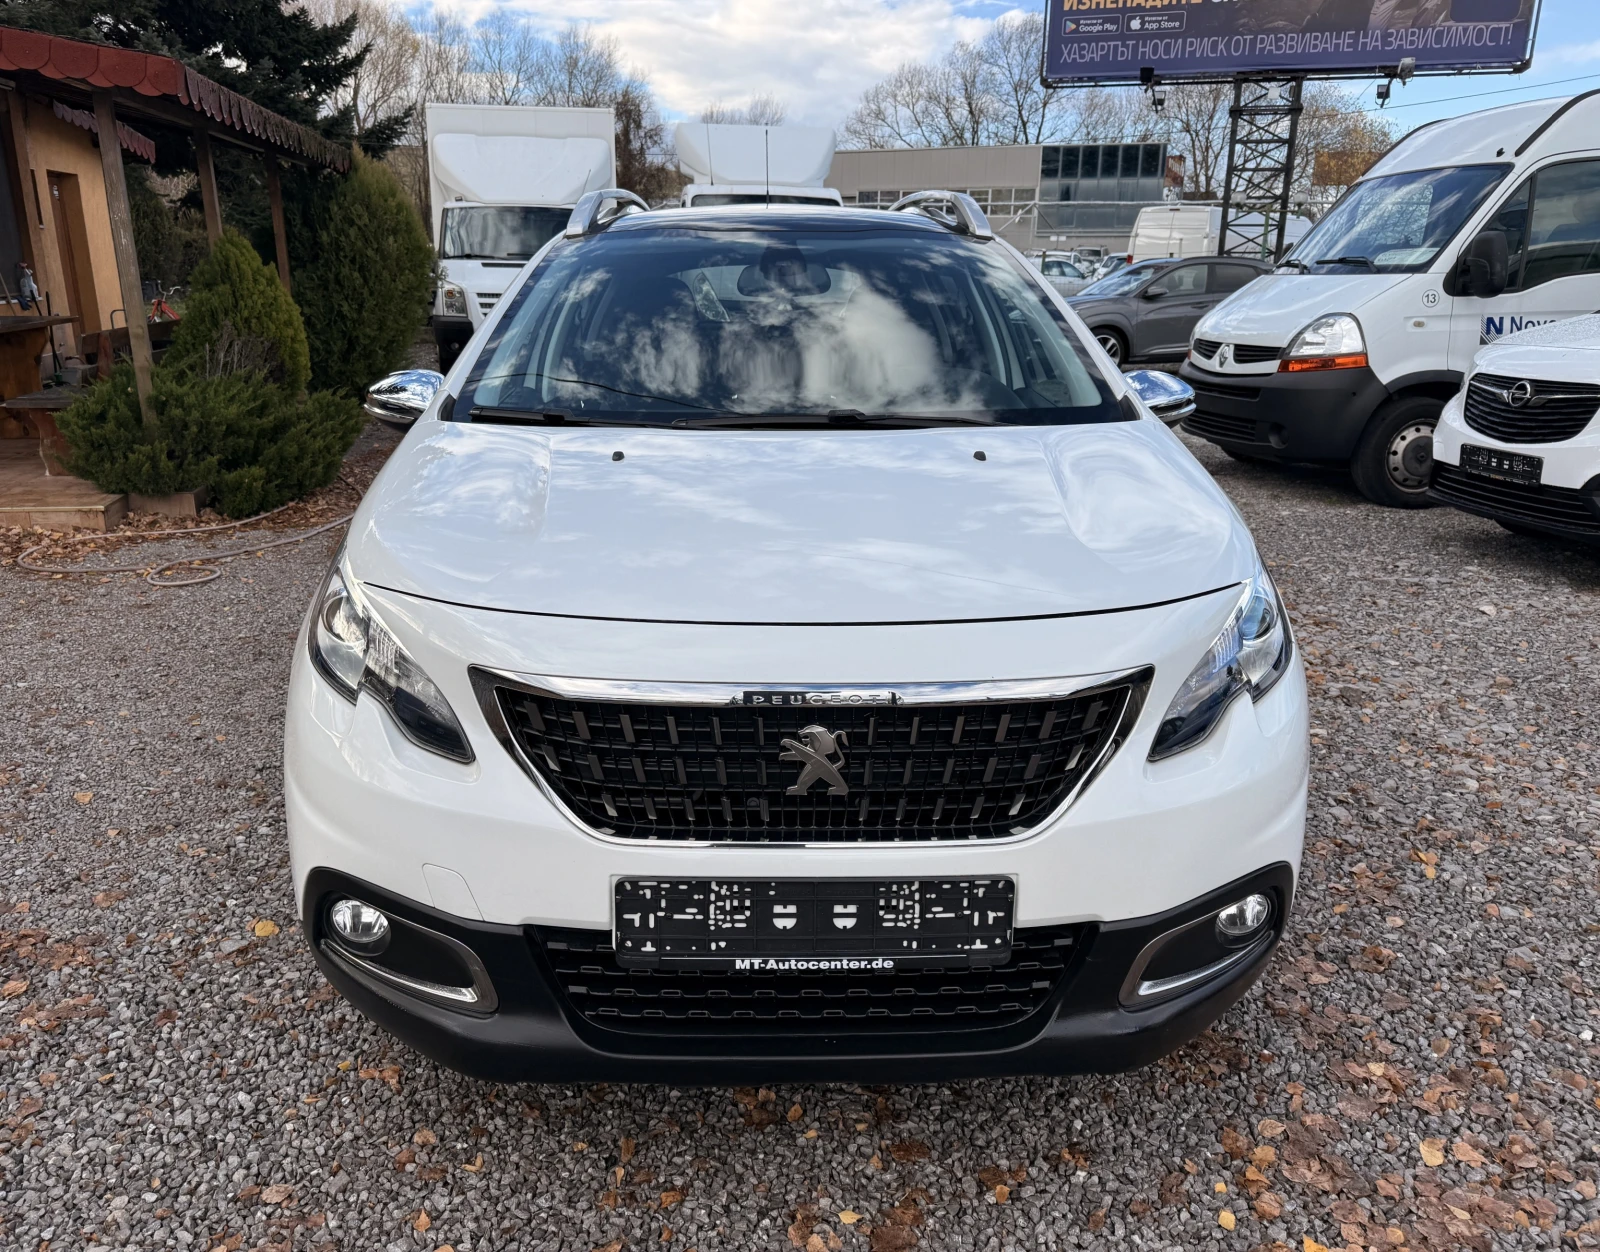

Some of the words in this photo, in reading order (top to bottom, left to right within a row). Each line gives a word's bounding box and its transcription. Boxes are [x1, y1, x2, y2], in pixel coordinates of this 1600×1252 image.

[1079, 24, 1103, 33] Google
[1103, 23, 1118, 32] Play
[1143, 22, 1160, 30] App
[1060, 40, 1136, 63] ХАЗАРТЪТ
[1138, 38, 1182, 60] НОСИ
[1185, 36, 1228, 58] РИСК
[1231, 35, 1254, 56] ОТ
[1255, 31, 1354, 55] РАЗВИВАНЕ
[1358, 29, 1382, 51] НА
[1385, 24, 1514, 50] ЗАВИСИМОСТ!
[1424, 293, 1437, 304] 13
[752, 694, 881, 705] PEUGEOT
[735, 958, 894, 970] MT-Autocenter.de
